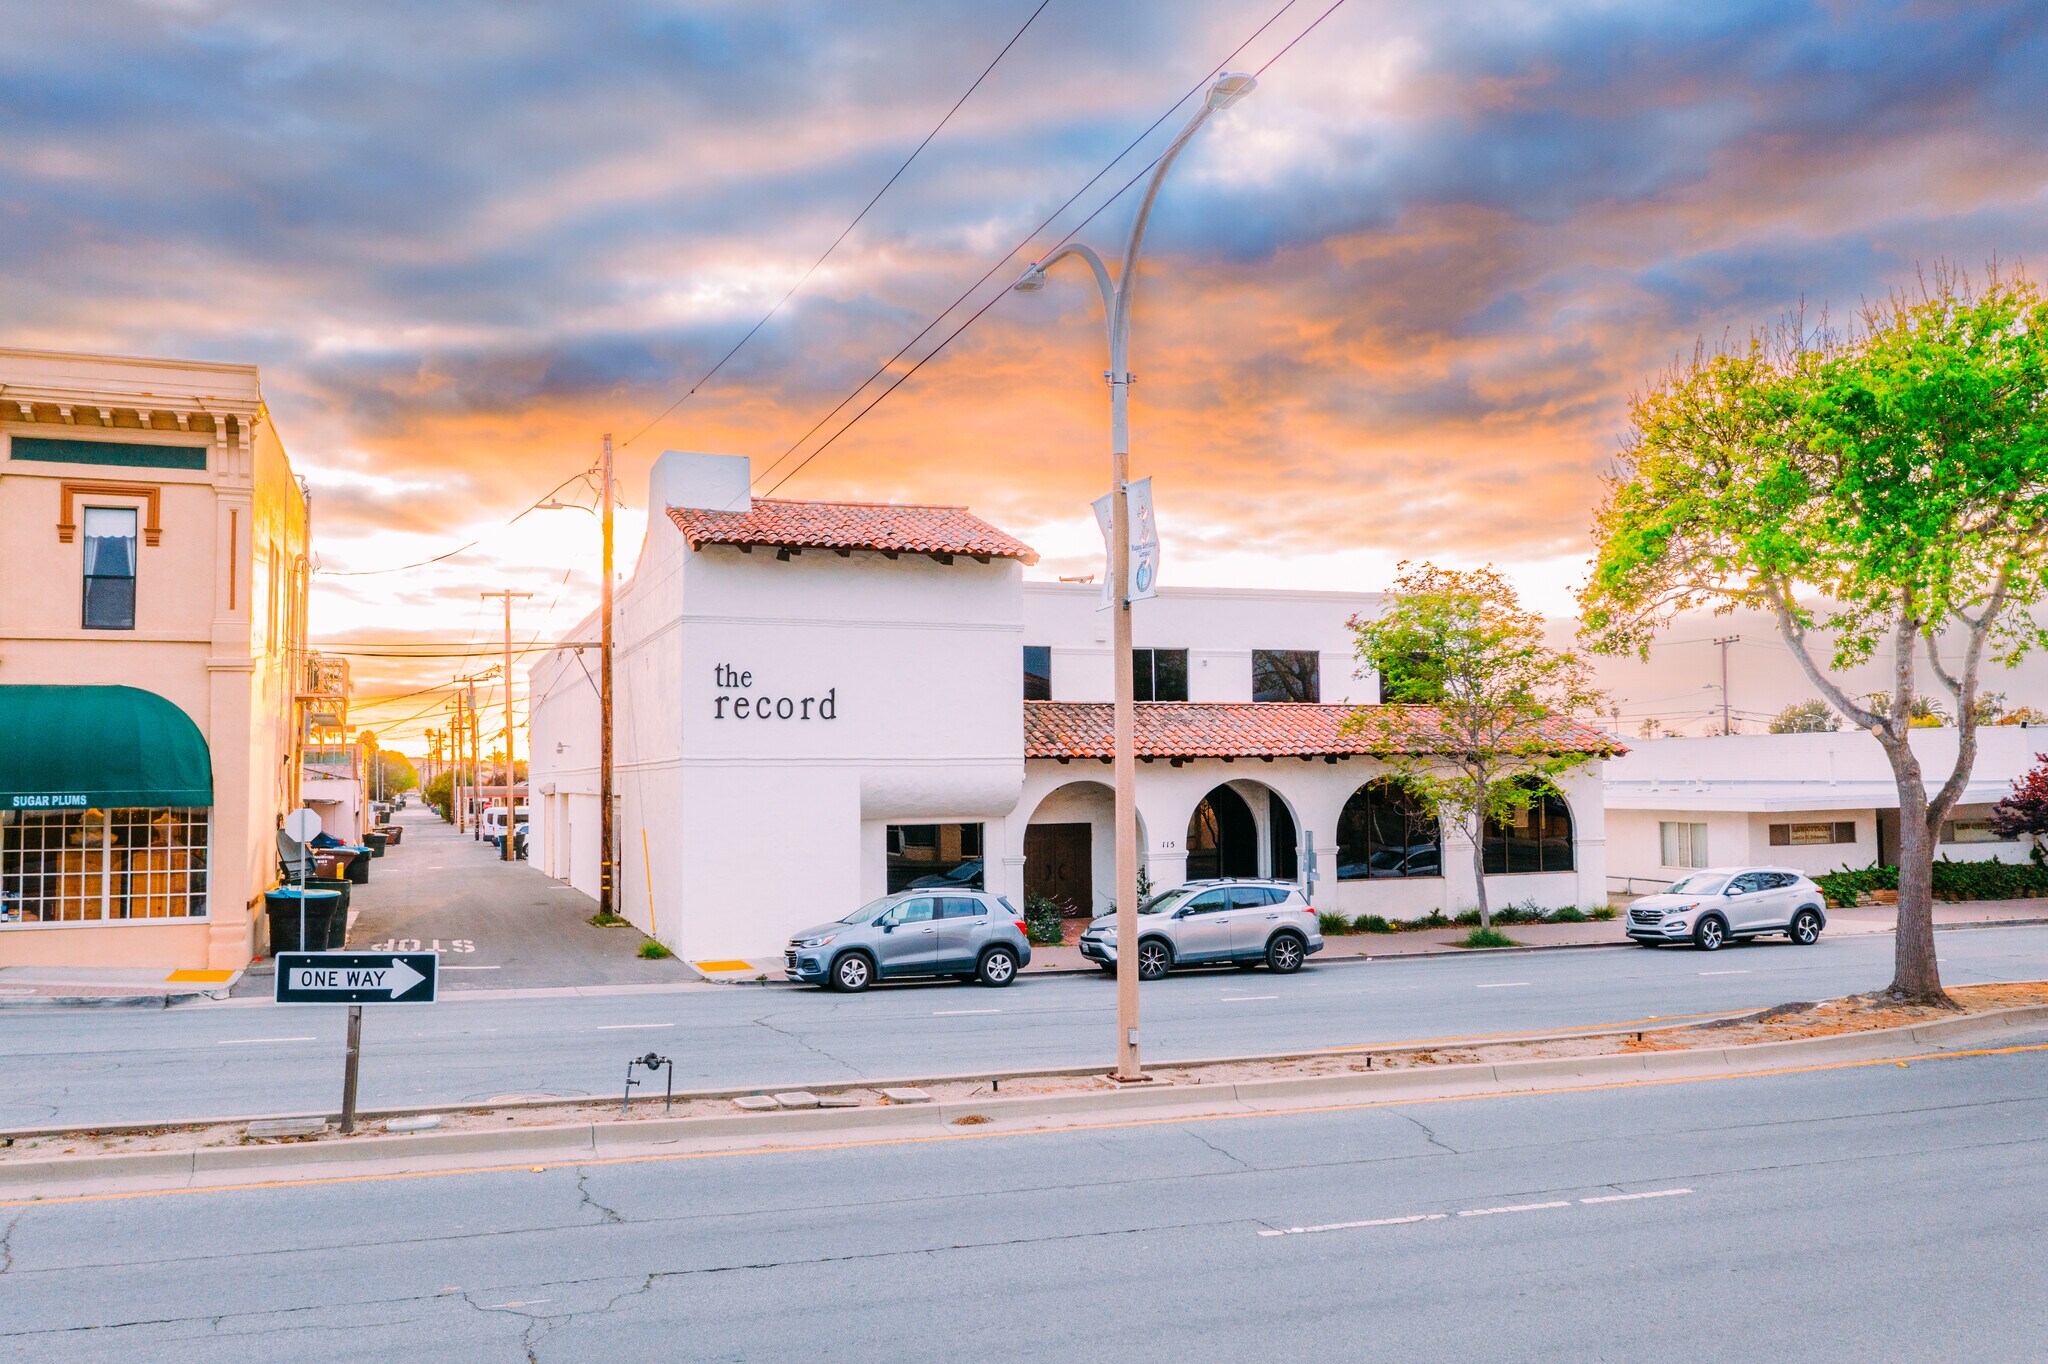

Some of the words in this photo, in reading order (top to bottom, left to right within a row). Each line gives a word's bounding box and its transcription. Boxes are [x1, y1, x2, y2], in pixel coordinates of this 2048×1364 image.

[714, 662, 752, 688] the
[714, 687, 837, 720] record
[13, 795, 49, 807] SUGAR
[51, 794, 87, 806] PLUMS
[371, 938, 476, 952] STOP
[301, 970, 338, 987] ONE
[347, 970, 386, 987] WAY
